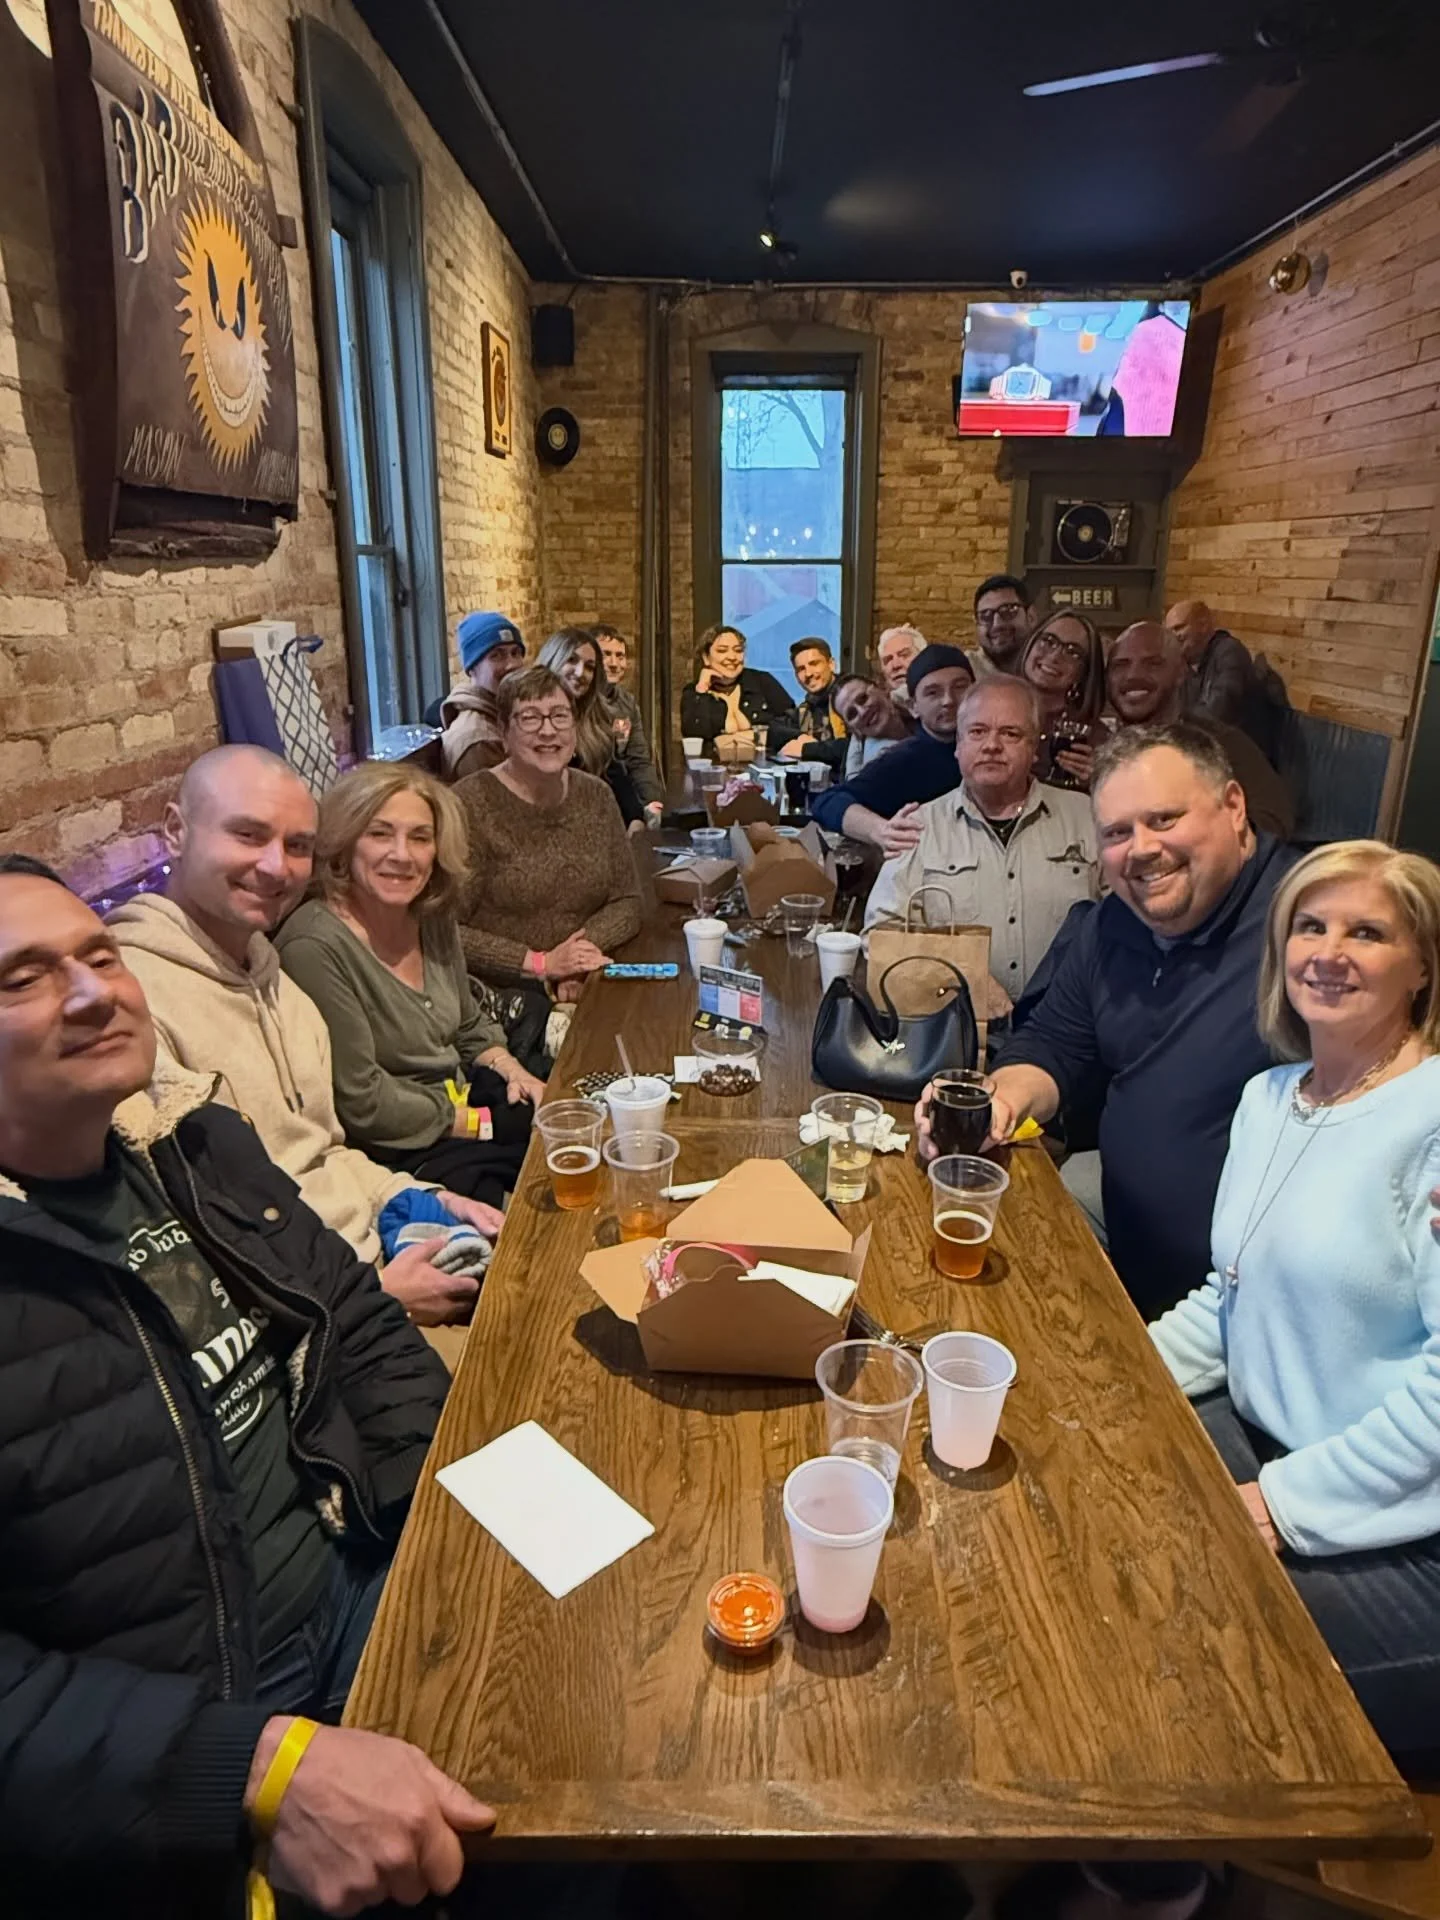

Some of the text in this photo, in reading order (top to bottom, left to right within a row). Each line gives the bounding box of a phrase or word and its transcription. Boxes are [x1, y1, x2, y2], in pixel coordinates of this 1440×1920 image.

[90, 0, 148, 75] THANKS
[109, 84, 181, 264] BAD
[124, 424, 188, 483] MASON
[1072, 589, 1113, 605] BEER
